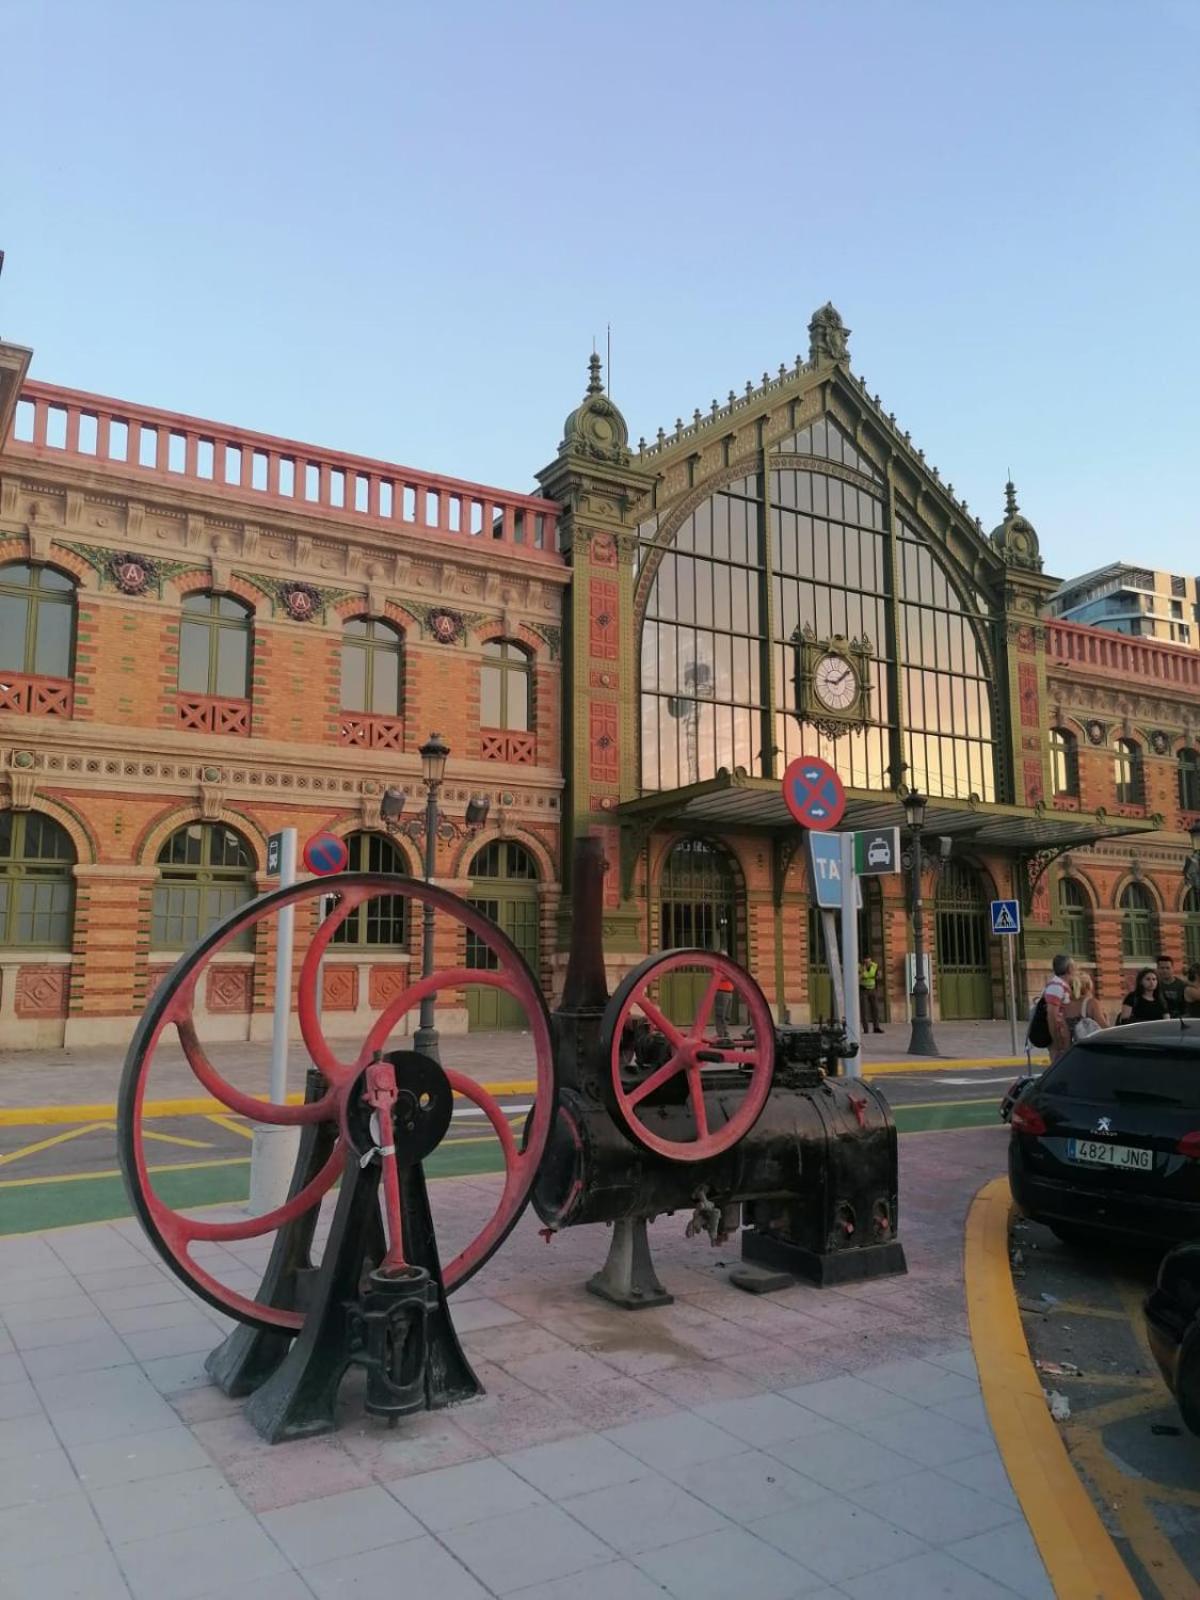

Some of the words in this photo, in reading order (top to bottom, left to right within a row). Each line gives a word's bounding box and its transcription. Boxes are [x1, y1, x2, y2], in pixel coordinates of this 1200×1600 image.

[816, 857, 843, 880] TA
[1079, 1142, 1116, 1162] 4821
[1121, 1149, 1149, 1168] JNG
